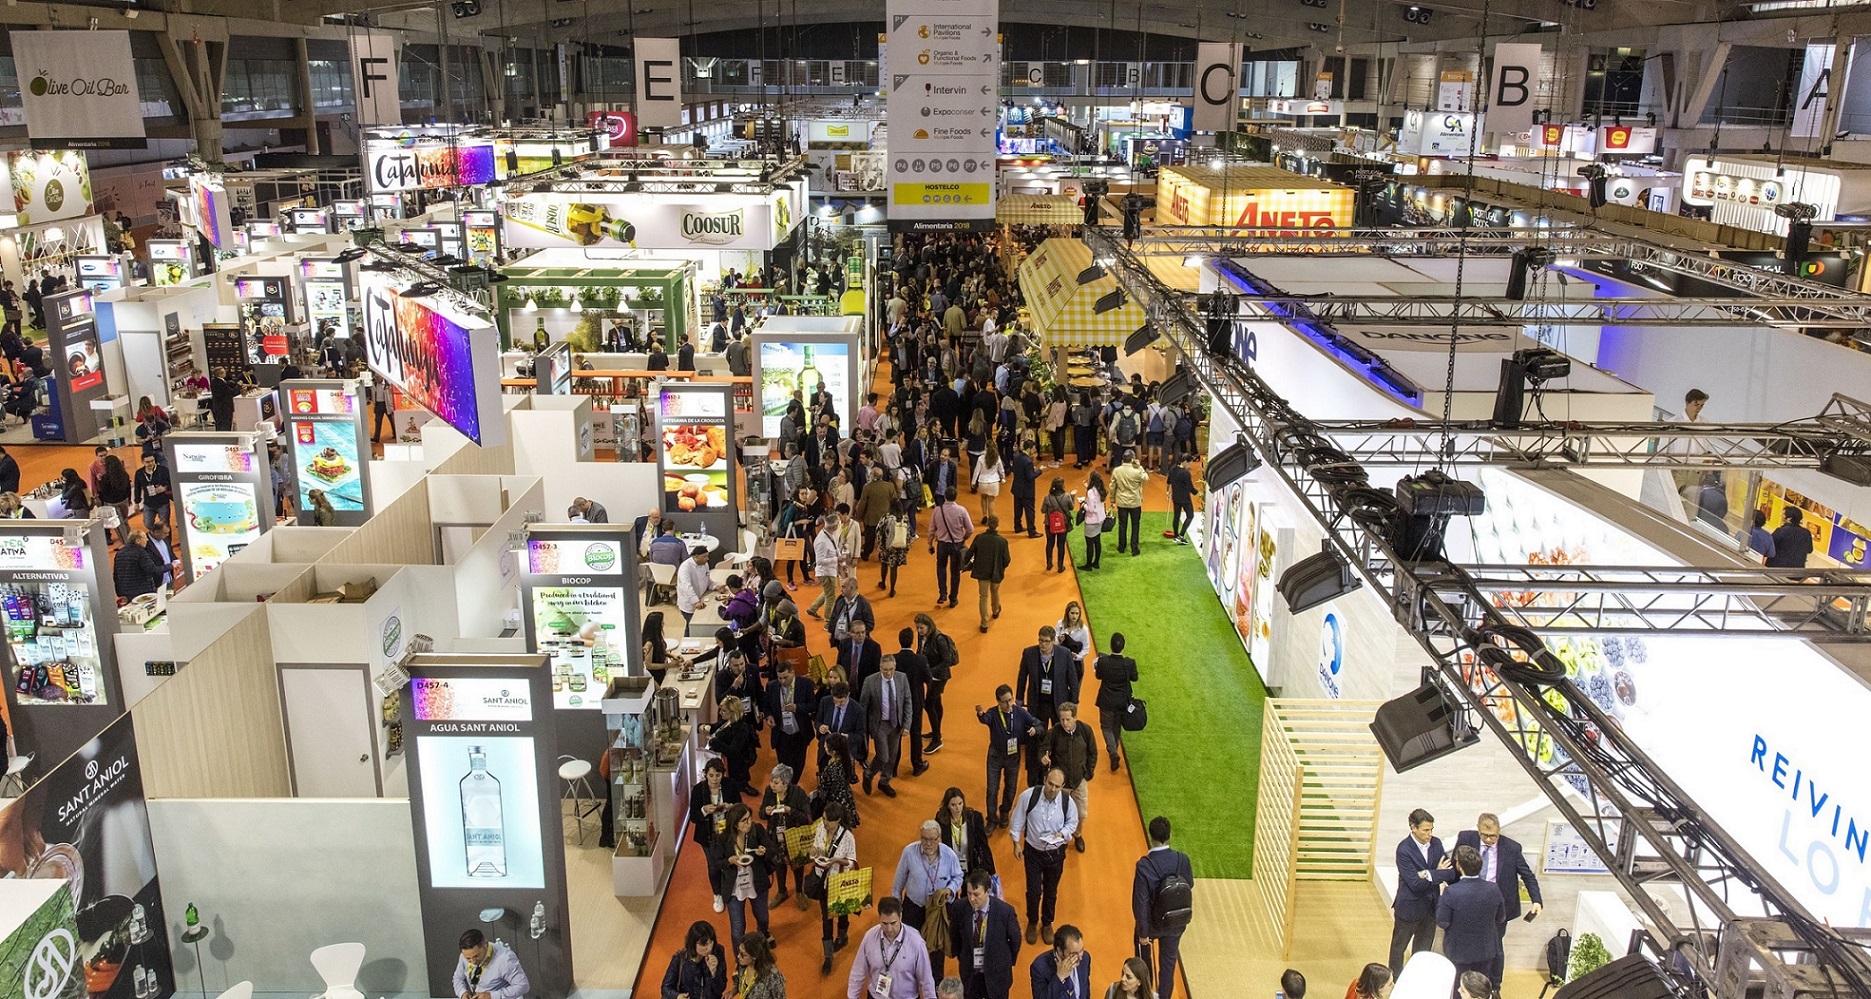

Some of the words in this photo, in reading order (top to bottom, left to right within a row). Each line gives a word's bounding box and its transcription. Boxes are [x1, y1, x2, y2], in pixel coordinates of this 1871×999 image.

[360, 58, 388, 98] F
[644, 60, 674, 100] E
[752, 67, 761, 81] F
[832, 67, 842, 81] E
[1029, 68, 1042, 84] C
[1129, 69, 1140, 83] B
[30, 76, 69, 96] Olive
[71, 79, 95, 96] Oil
[97, 78, 129, 96] Bar
[934, 86, 966, 94] Intervin
[1201, 64, 1235, 105] C
[1497, 66, 1529, 106] B
[1802, 68, 1830, 109] A
[934, 108, 975, 116] Expoconser
[1170, 185, 1189, 225] ANETO
[683, 213, 742, 235] COOSUR
[1230, 202, 1336, 238] ANETO
[1473, 218, 1489, 228] FOODS
[1474, 208, 1498, 223] PORTUGAL
[1360, 331, 1511, 341] DANONE
[430, 724, 458, 732] AGUA
[460, 724, 486, 732] SANT
[489, 724, 520, 732] ANIOL
[58, 784, 90, 822] SANT
[92, 756, 129, 794] ANIOL
[66, 806, 88, 826] NATURAL
[88, 788, 110, 806] MINERAL
[110, 774, 126, 788] WATER
